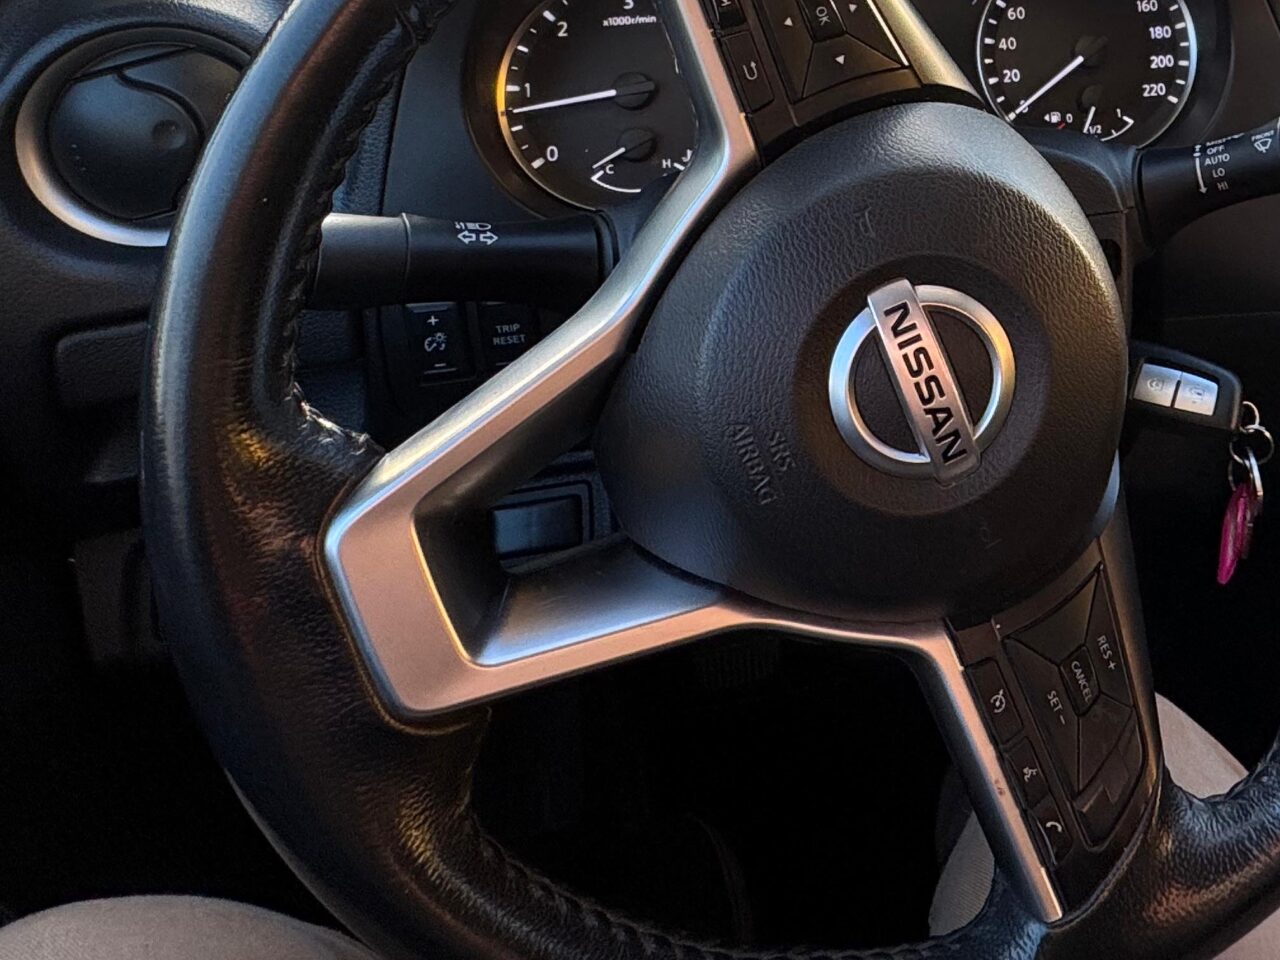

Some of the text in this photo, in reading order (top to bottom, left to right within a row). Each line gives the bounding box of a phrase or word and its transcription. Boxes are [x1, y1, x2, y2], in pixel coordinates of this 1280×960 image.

[815, 5, 831, 26] OK
[1007, 0, 1158, 21] 60 160
[557, 21, 569, 37] 2
[1149, 25, 1172, 39] 180
[998, 36, 1017, 51] 40
[1149, 55, 1174, 69] 200
[1003, 69, 1021, 83] 20
[524, 82, 532, 98] 1
[1142, 82, 1166, 97] 220
[546, 146, 559, 161] 0
[1206, 144, 1225, 155] OFF
[605, 158, 671, 175] C H
[1204, 153, 1230, 166] AUTO
[1212, 167, 1226, 178] LO
[1216, 181, 1229, 191] HI
[495, 322, 520, 333] TRIP
[492, 334, 527, 346] RESET
[884, 300, 967, 464] NISSAN
[1070, 659, 1093, 704] CANCEL
